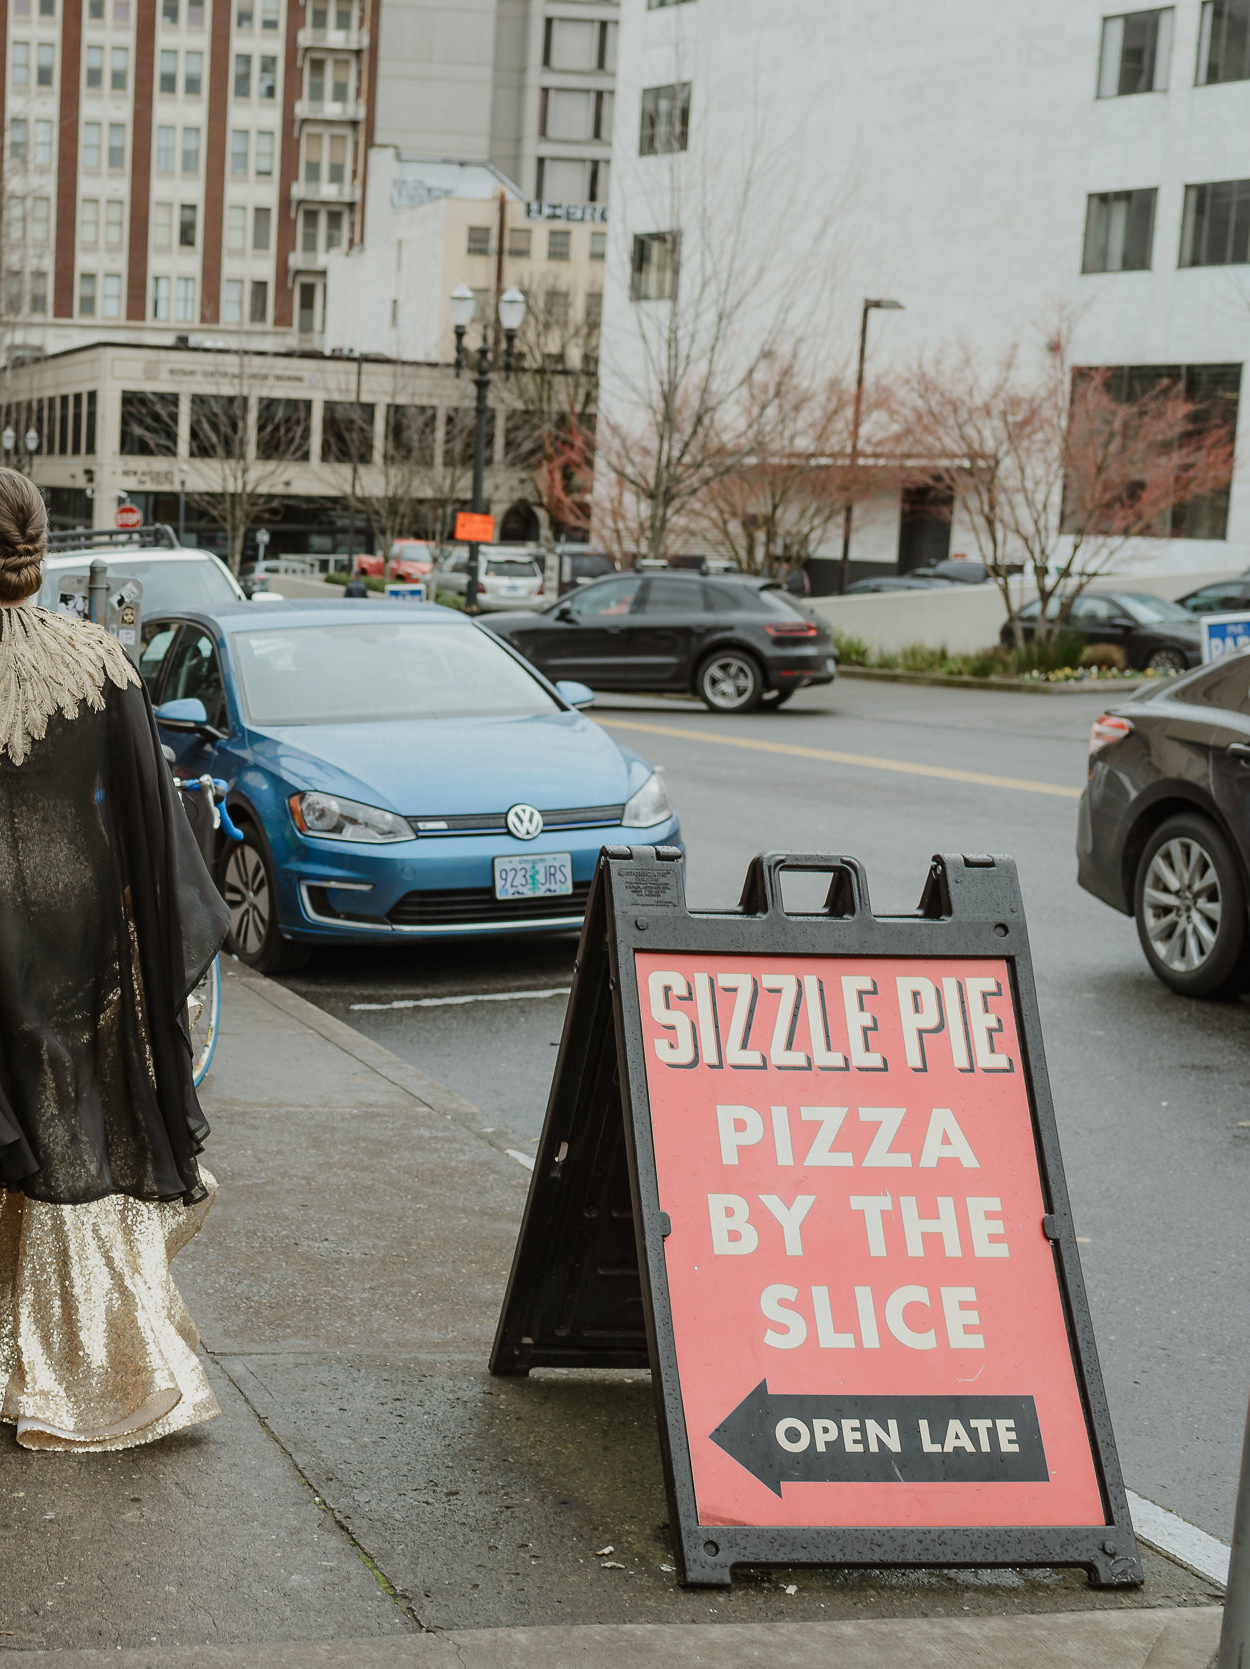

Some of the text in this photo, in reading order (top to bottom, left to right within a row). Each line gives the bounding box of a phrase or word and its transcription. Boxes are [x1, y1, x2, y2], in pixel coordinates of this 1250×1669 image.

[499, 864, 568, 889] 923 JRS
[648, 970, 1015, 1073] SIZZLE PIE
[715, 1104, 981, 1168] PIZZA
[706, 1193, 1011, 1258] BY THE
[759, 1283, 986, 1351] SLICE
[774, 1417, 1020, 1453] OPEN LATE
